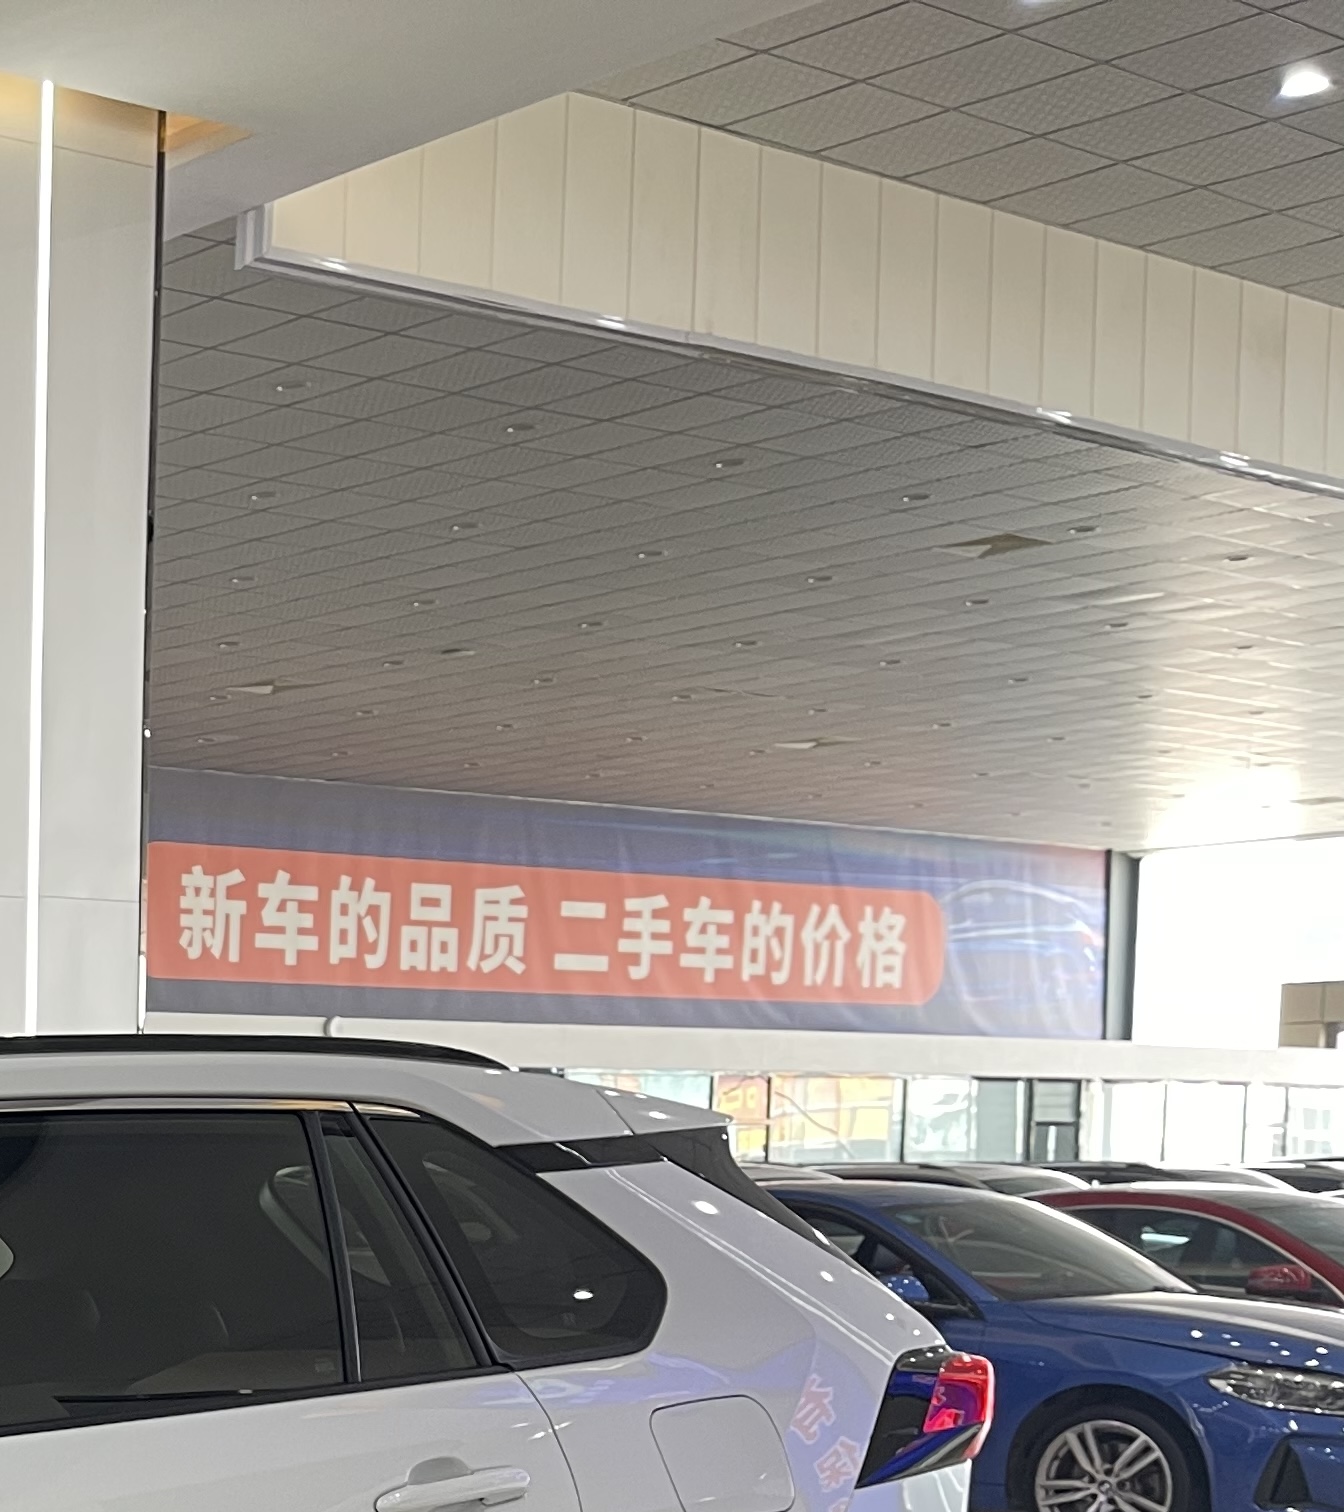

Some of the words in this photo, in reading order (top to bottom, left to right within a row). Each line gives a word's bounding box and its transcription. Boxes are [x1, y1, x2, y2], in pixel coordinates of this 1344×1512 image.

[178, 864, 529, 976] 新车的品质
[553, 893, 908, 990] 二手车的价格
